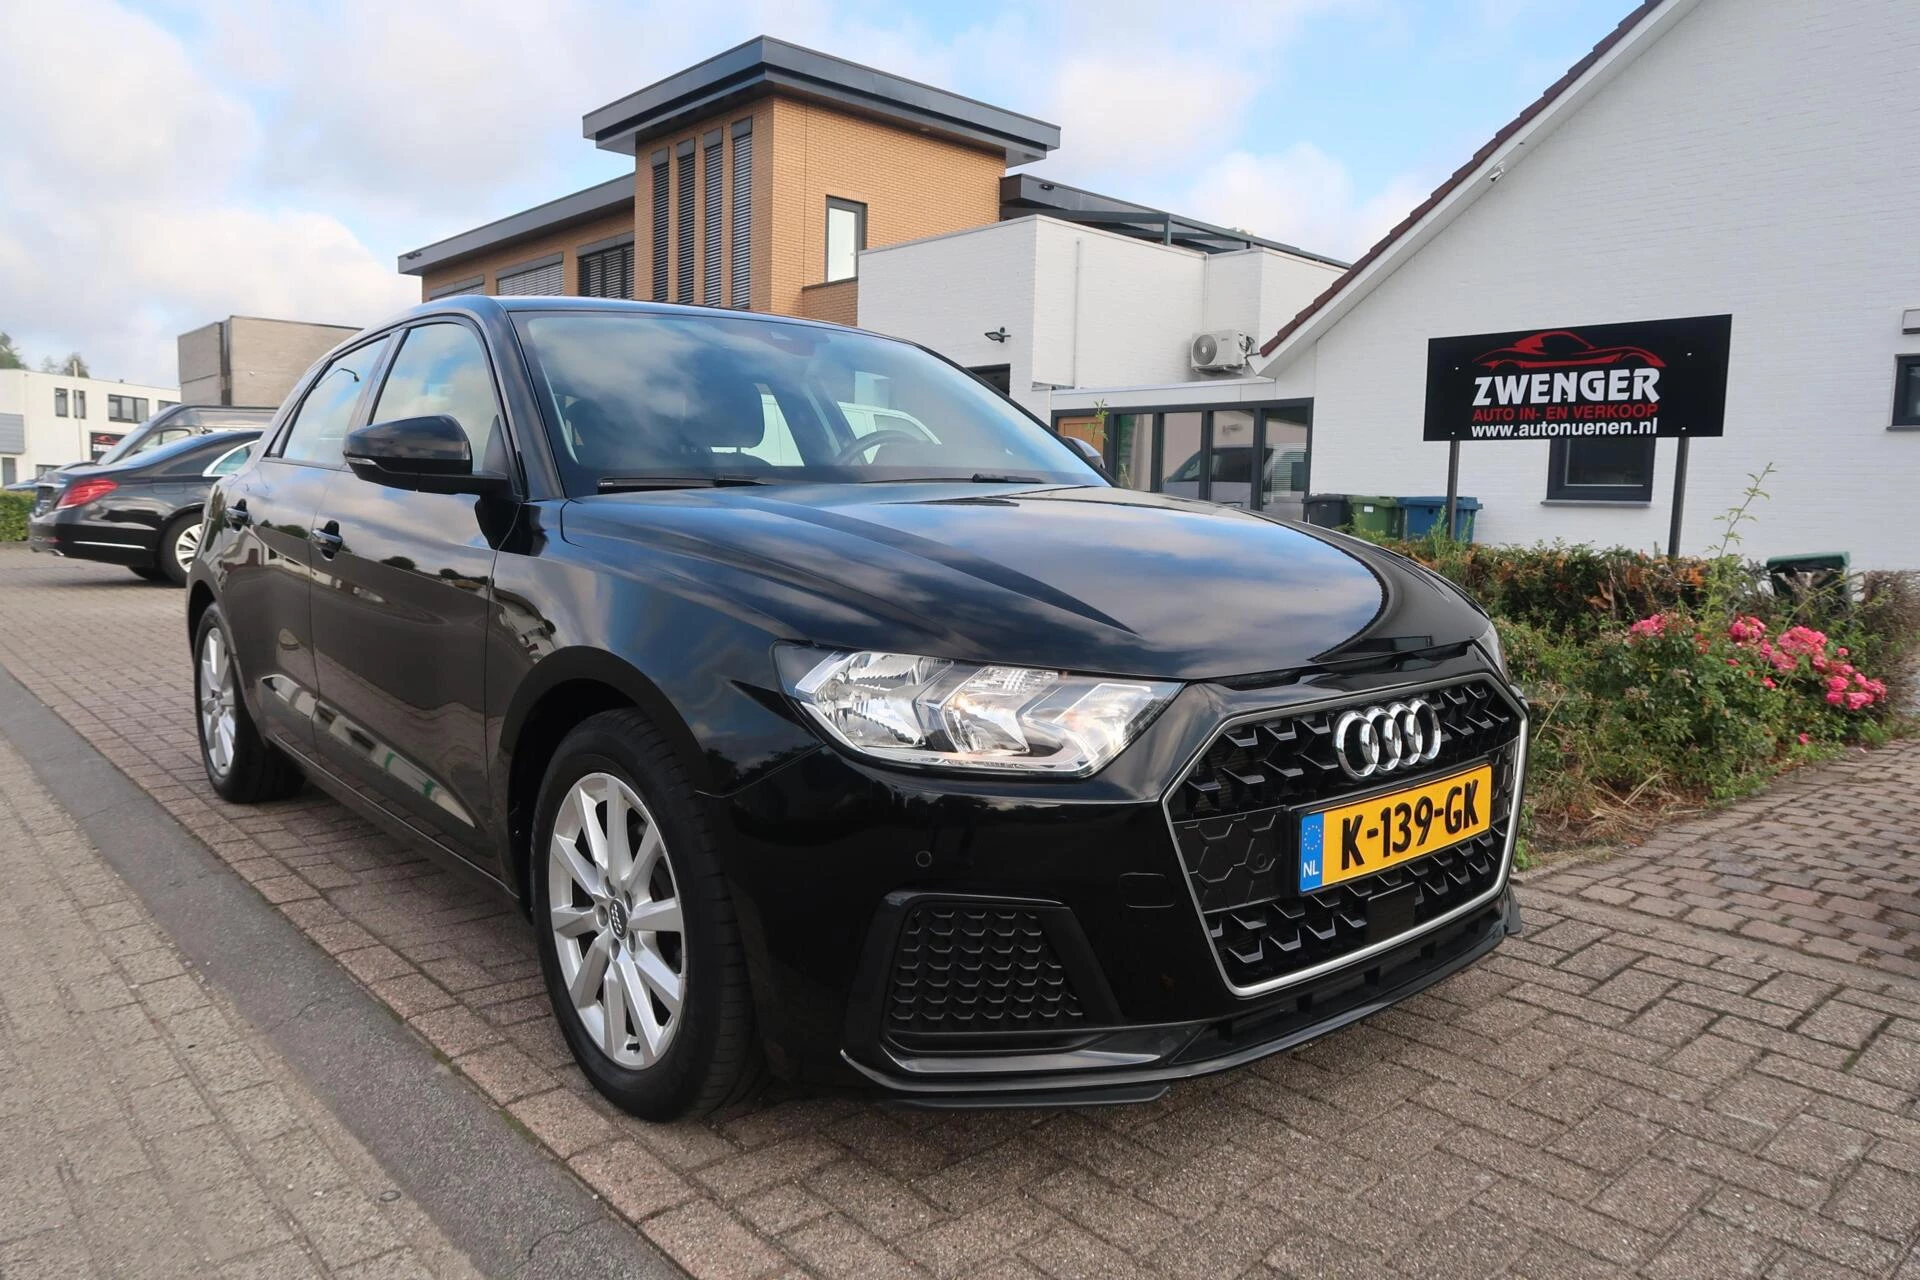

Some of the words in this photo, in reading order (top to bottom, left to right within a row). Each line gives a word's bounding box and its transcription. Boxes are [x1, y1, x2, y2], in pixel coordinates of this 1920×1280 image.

[1472, 368, 1660, 406] ZWENGER
[1472, 408, 1514, 421] AUTO
[1519, 408, 1541, 420] IN-
[1546, 406, 1568, 419] EN
[1573, 404, 1658, 419] VERKOOP
[1471, 417, 1658, 437] www.autonuenen.nl
[1341, 779, 1479, 870] K-139-GK
[1303, 859, 1319, 878] NL
